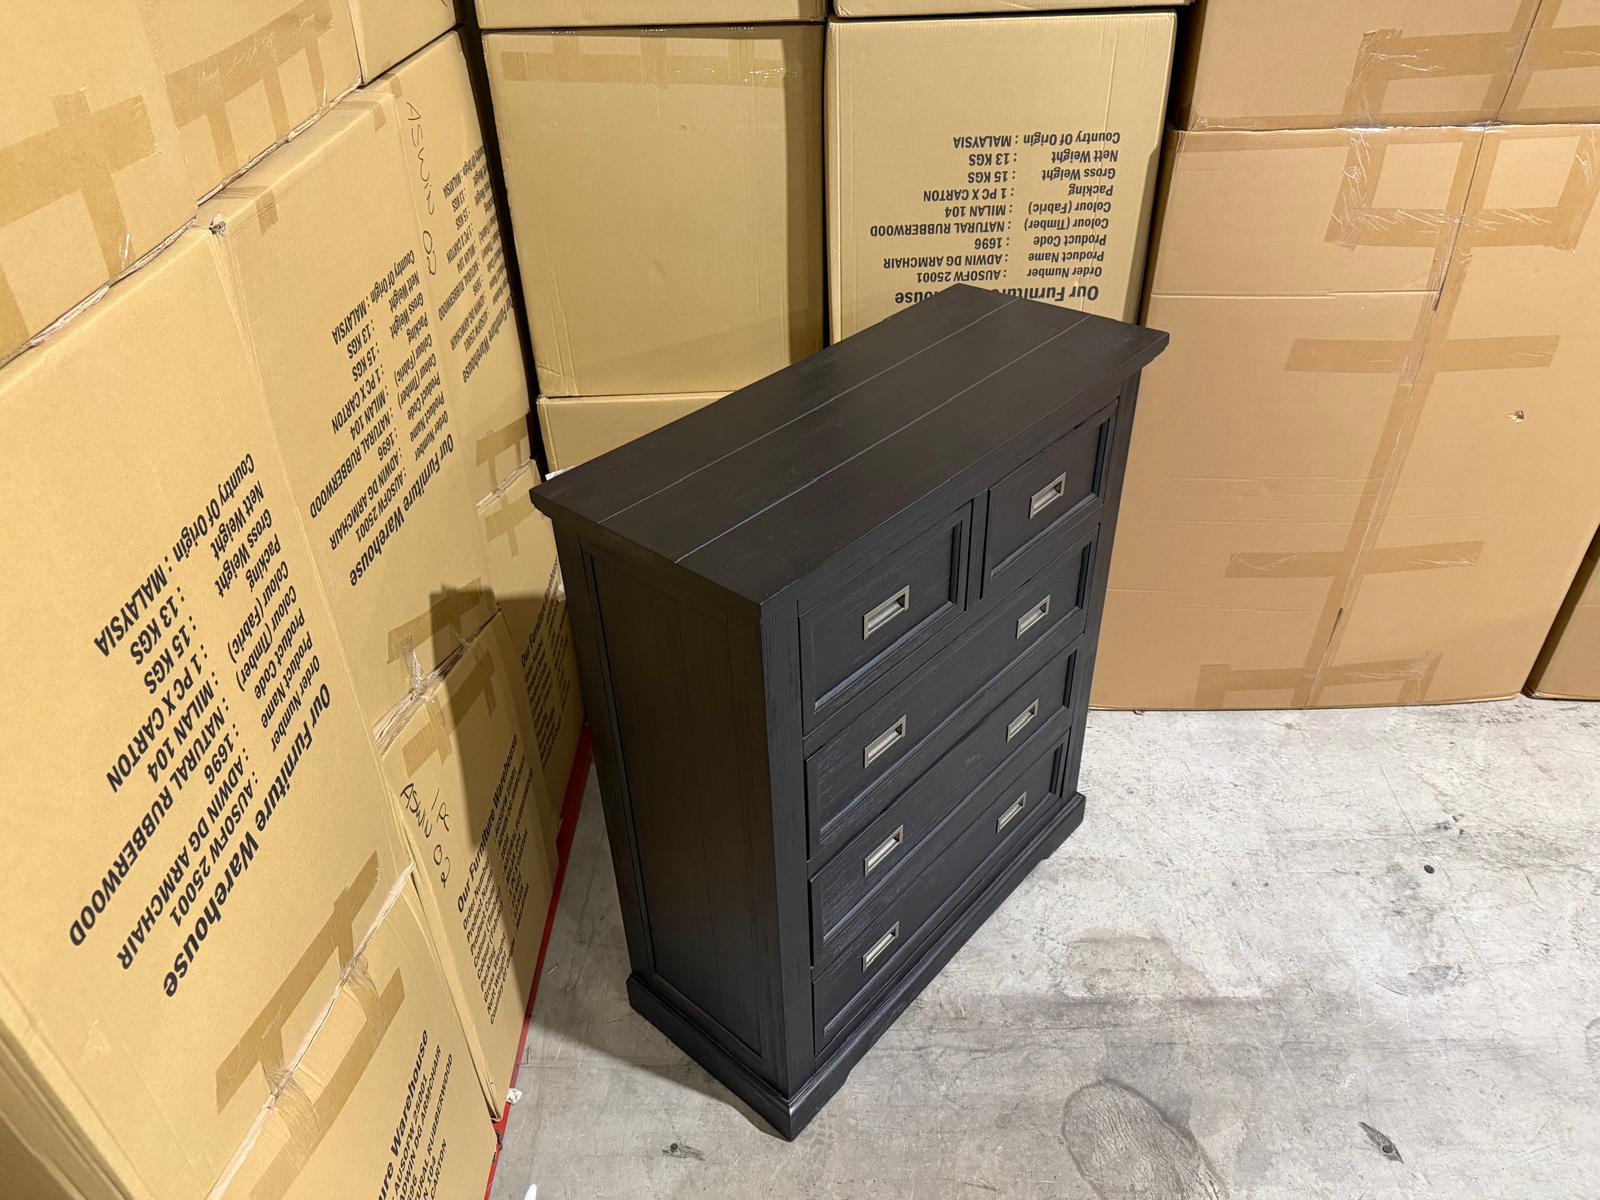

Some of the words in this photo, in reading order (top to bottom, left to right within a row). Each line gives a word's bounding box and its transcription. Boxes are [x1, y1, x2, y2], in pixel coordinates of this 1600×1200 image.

[953, 135, 1011, 147] MALAYSIA
[1023, 131, 1056, 145] Origin
[1059, 133, 1072, 145] Of
[1075, 130, 1119, 143] Country
[968, 153, 991, 165] KGS
[995, 152, 1009, 164] 13
[1051, 148, 1090, 163] Weight
[1093, 149, 1117, 161] Nett
[967, 171, 990, 183] KGS
[994, 170, 1007, 182] 15
[1041, 166, 1080, 180] Weight
[1083, 167, 1115, 179] Gross
[923, 189, 968, 201] CARTON
[971, 188, 979, 199] X
[981, 188, 996, 199] PC
[1000, 187, 1006, 198] 1
[1067, 183, 1113, 196] Packing
[944, 205, 965, 217] 104
[969, 204, 1005, 216] MILAN
[1028, 200, 1071, 214] (Fabric)
[1074, 201, 1110, 212] Colour
[870, 223, 950, 236] RUBBERWOOD
[953, 221, 1004, 233] NATURAL
[1024, 216, 1069, 230] (Timber)
[1072, 218, 1108, 228] Colour
[974, 237, 1002, 249] 1696
[1033, 235, 1060, 246] Code
[1063, 234, 1106, 246] Product
[393, 249, 414, 277] Country
[883, 256, 943, 268] ARMCHAIR
[946, 255, 961, 266] DG
[964, 254, 1002, 265] ADWIN
[1028, 252, 1059, 262] Name
[1061, 251, 1103, 261] Product
[387, 270, 394, 289] Of
[406, 270, 419, 292] Nett
[916, 271, 951, 282] 25001
[953, 269, 1000, 281] AUSOFW
[1026, 267, 1069, 278] Number
[1071, 266, 1101, 276] Order
[370, 277, 387, 302] Origin
[388, 283, 408, 312] Weight
[408, 292, 423, 314] Gross
[1068, 285, 1098, 300] Our
[331, 299, 366, 344] MALAYSIA
[361, 323, 370, 343] 13
[389, 308, 409, 339] Weight
[406, 312, 427, 345] Packing
[346, 333, 362, 358] KGS
[366, 346, 375, 366] 15
[415, 333, 431, 359] Colour
[352, 355, 367, 381] KGS
[374, 368, 380, 383] 1
[394, 350, 415, 387] (Fabric)
[419, 353, 436, 379] Colour
[359, 384, 366, 402] X
[365, 373, 375, 394] PC
[397, 370, 419, 409] (Timber)
[420, 371, 440, 405] Product
[331, 391, 360, 433] CARTON
[364, 389, 385, 424] MILAN
[407, 397, 421, 420] Code
[424, 390, 444, 424] Product
[350, 414, 363, 440] 104
[360, 411, 390, 453] NATURAL
[409, 416, 425, 441] Name
[434, 410, 447, 433] Order
[377, 431, 393, 460] 1696
[414, 428, 434, 460] Number
[439, 433, 453, 460] Our
[217, 453, 253, 506] Country
[310, 445, 361, 518] RUBBERWOOD
[377, 450, 398, 487] ADWIN
[403, 452, 439, 511] Furniture
[242, 480, 263, 516] Nett
[367, 478, 378, 500] DG
[377, 470, 402, 515] AUSOFW
[205, 498, 219, 527] Of
[329, 491, 367, 549] ARMCHAIR
[355, 505, 377, 542] 25001
[172, 514, 207, 561] Origin
[210, 506, 246, 560] Weight
[246, 508, 271, 548] Gross
[349, 505, 404, 585] Warehouse
[214, 542, 249, 597] Weight
[245, 533, 280, 592] Packing
[262, 560, 287, 607] Colour
[93, 564, 167, 656] MALAYSIA
[159, 595, 177, 627] 13
[271, 585, 295, 631] Colour
[130, 617, 161, 664] KGS
[171, 624, 189, 658] 15
[227, 597, 263, 663] (Fabric)
[274, 607, 304, 666] Product
[143, 647, 173, 694] KGS
[190, 653, 201, 674] 1
[235, 622, 272, 691] (Timber)
[282, 630, 312, 689] Product
[173, 666, 193, 700] PC
[254, 659, 276, 699] Code
[299, 655, 319, 695] Order
[161, 689, 175, 716] X
[173, 680, 213, 745] MILAN
[261, 681, 285, 728] Name
[309, 683, 329, 727] Our
[271, 690, 301, 751] Number
[106, 707, 163, 792] CARTON
[147, 737, 174, 782] 104
[169, 705, 224, 790] NATURAL
[204, 732, 233, 784] 1696
[206, 755, 243, 823] ADWIN
[255, 720, 311, 831] Furniture
[188, 816, 208, 852] DG
[209, 778, 252, 864] AUSOFW
[69, 785, 172, 945] RUBBERWOOD
[169, 855, 210, 926] 25001
[116, 845, 189, 969] ARMCHAIR
[163, 831, 258, 996] Warehouse
[390, 1029, 427, 1156] Warehouse
[414, 1124, 422, 1149] DG
[421, 1044, 440, 1125] ARMCHAIR
[427, 1053, 452, 1156] RUBBERWOOD
[394, 1122, 414, 1195] AUSOFW
[413, 1074, 427, 1124] 25001
[427, 1155, 435, 1187] 104
